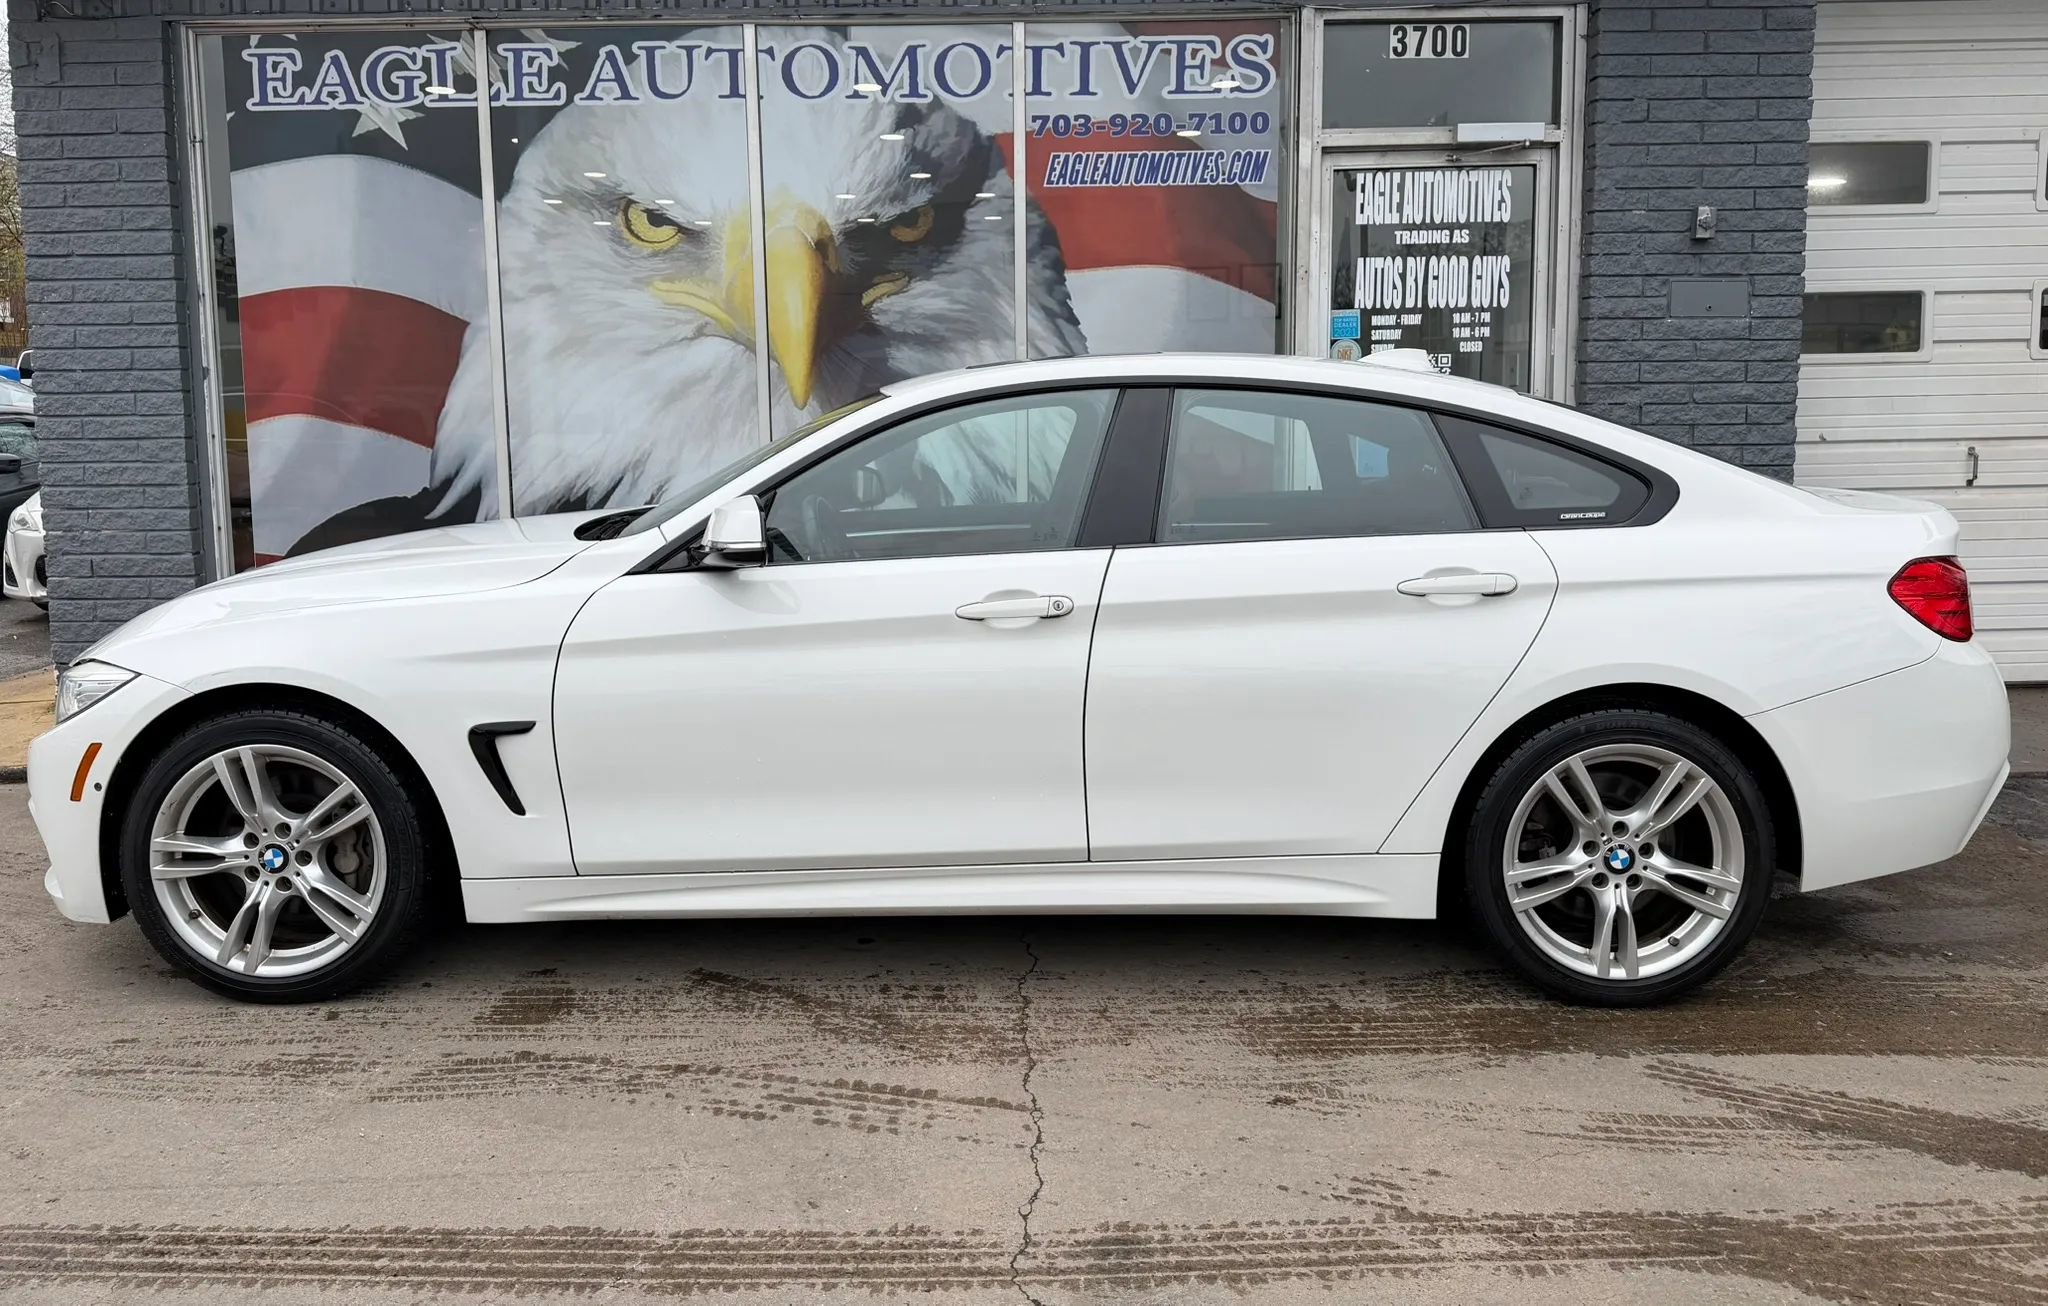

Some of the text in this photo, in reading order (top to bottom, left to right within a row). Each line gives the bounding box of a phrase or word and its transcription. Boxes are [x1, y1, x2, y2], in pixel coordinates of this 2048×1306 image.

[1392, 25, 1467, 57] 3700
[243, 35, 1275, 109] EAGLE AUTOMOTIVES
[1031, 112, 1270, 137] 703-920-7100
[1044, 149, 1271, 187] EAGLEAUTOMOTIVES.COM
[1355, 169, 1512, 225] EAGLE AUTOMOTIVES
[1394, 229, 1470, 244] TRADING AS
[1354, 254, 1511, 309] AUTOS BY GOOD GUYS
[1371, 315, 1397, 326] MONDAY
[1401, 314, 1422, 325] FRIDAY
[1453, 312, 1460, 324] 10
[1460, 312, 1471, 324] AM
[1475, 312, 1480, 323] 7
[1480, 312, 1491, 323] PM
[1371, 329, 1402, 340] SATURDAY
[1453, 327, 1460, 338] 10
[1460, 327, 1471, 338] AM
[1480, 327, 1490, 337] PM
[1460, 341, 1483, 352] CLOSED
